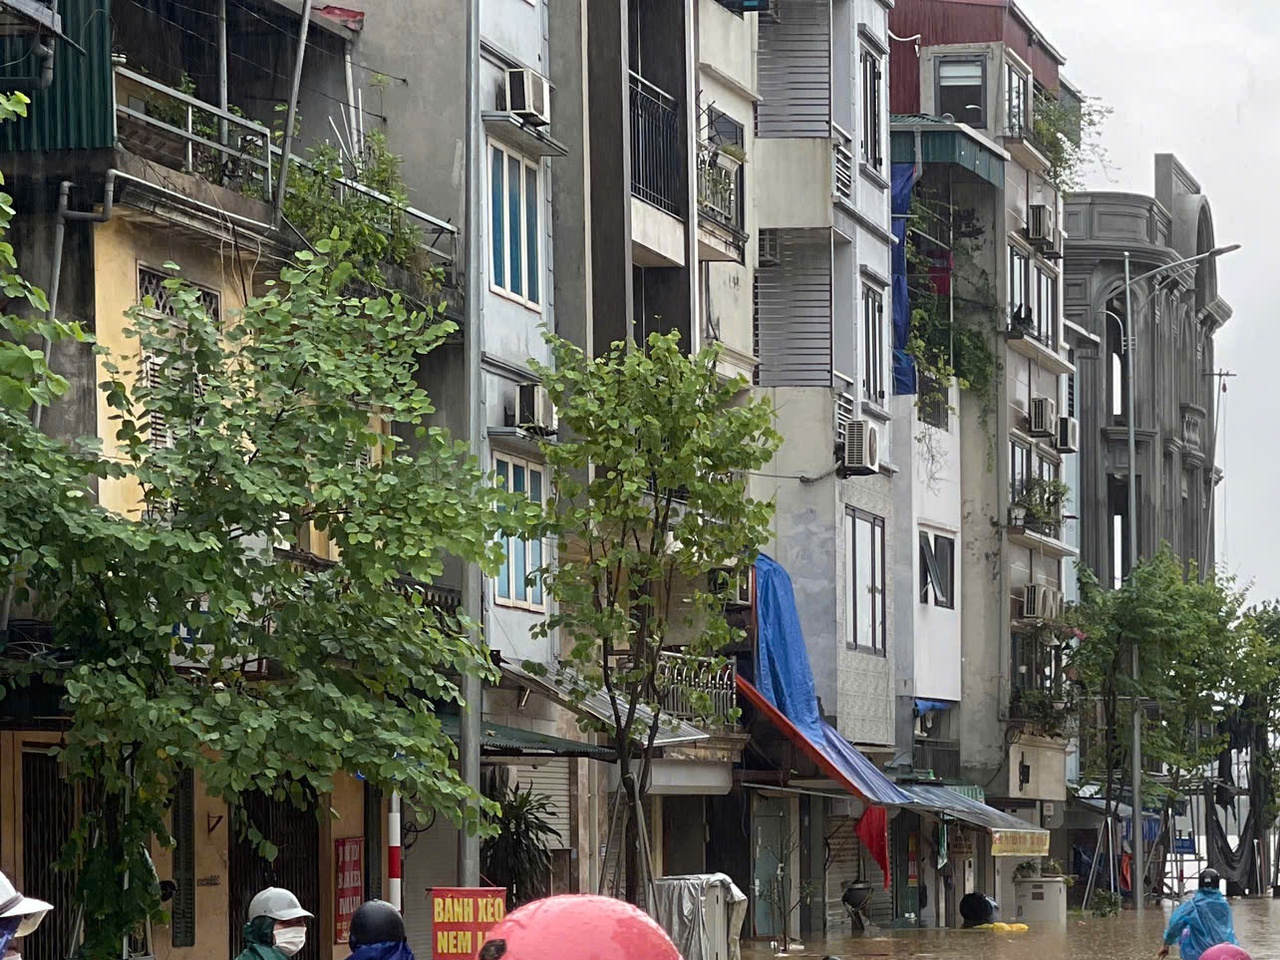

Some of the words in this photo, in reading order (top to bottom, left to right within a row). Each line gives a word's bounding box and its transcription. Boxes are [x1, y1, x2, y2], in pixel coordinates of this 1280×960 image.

[434, 893, 474, 922] BÁNH
[478, 893, 504, 922] XÈO
[437, 931, 472, 954] NEM
